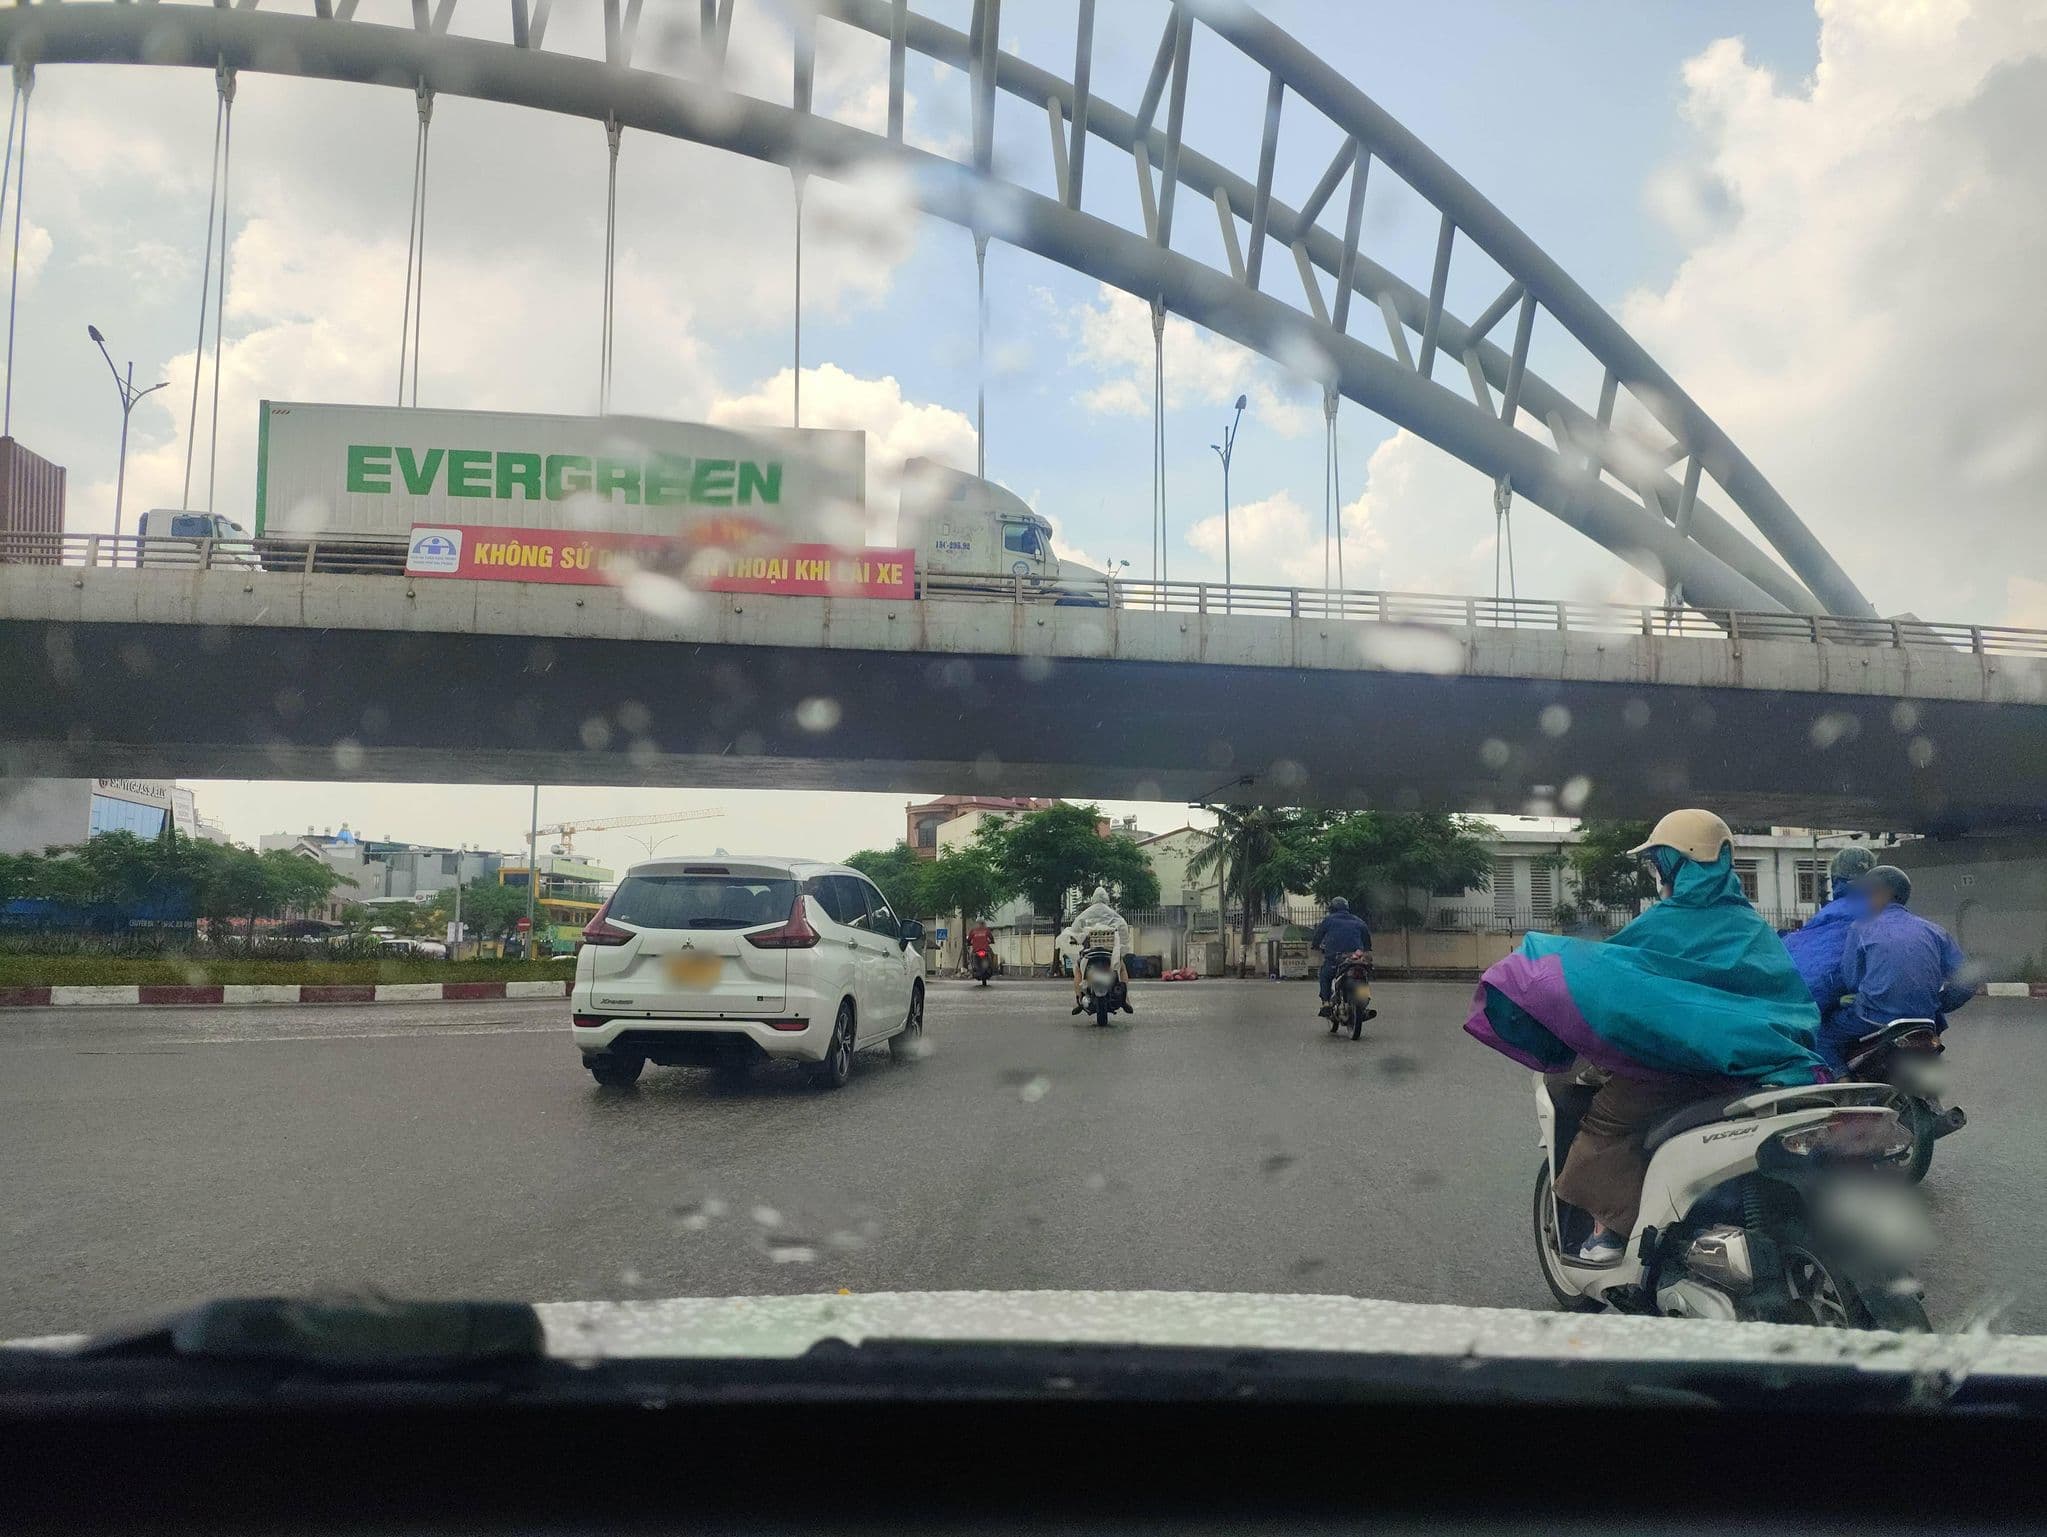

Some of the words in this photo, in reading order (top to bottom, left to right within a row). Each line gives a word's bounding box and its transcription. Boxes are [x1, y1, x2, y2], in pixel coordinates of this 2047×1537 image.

[347, 445, 782, 505] EVERGREEN
[474, 540, 553, 568] KHÔNG
[560, 541, 594, 569] SỬ
[795, 559, 830, 581] KHI
[876, 563, 903, 584] XE
